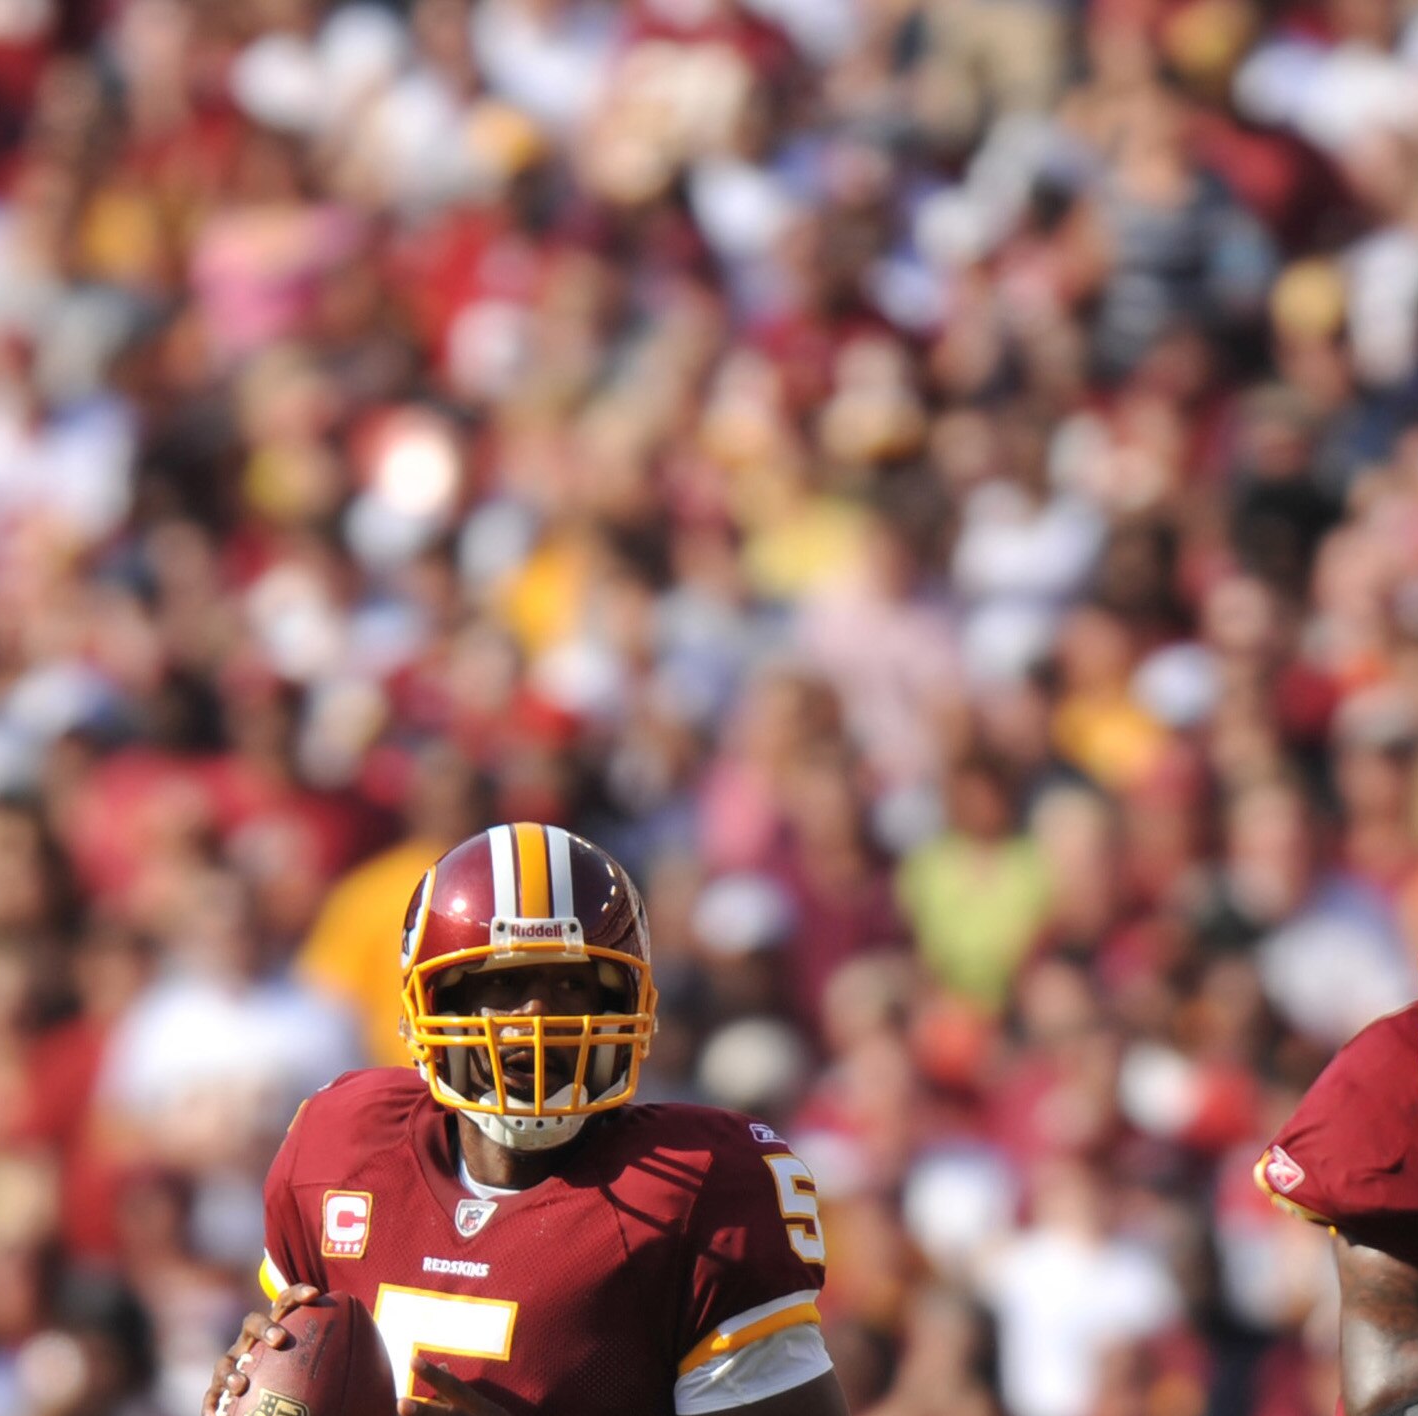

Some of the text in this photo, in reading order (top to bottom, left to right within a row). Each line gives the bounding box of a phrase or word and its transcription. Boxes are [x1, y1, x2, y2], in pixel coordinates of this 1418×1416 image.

[510, 922, 563, 938] Riddell
[326, 1195, 368, 1242] C
[762, 1153, 827, 1266] 5
[421, 1256, 490, 1278] REDSKINS
